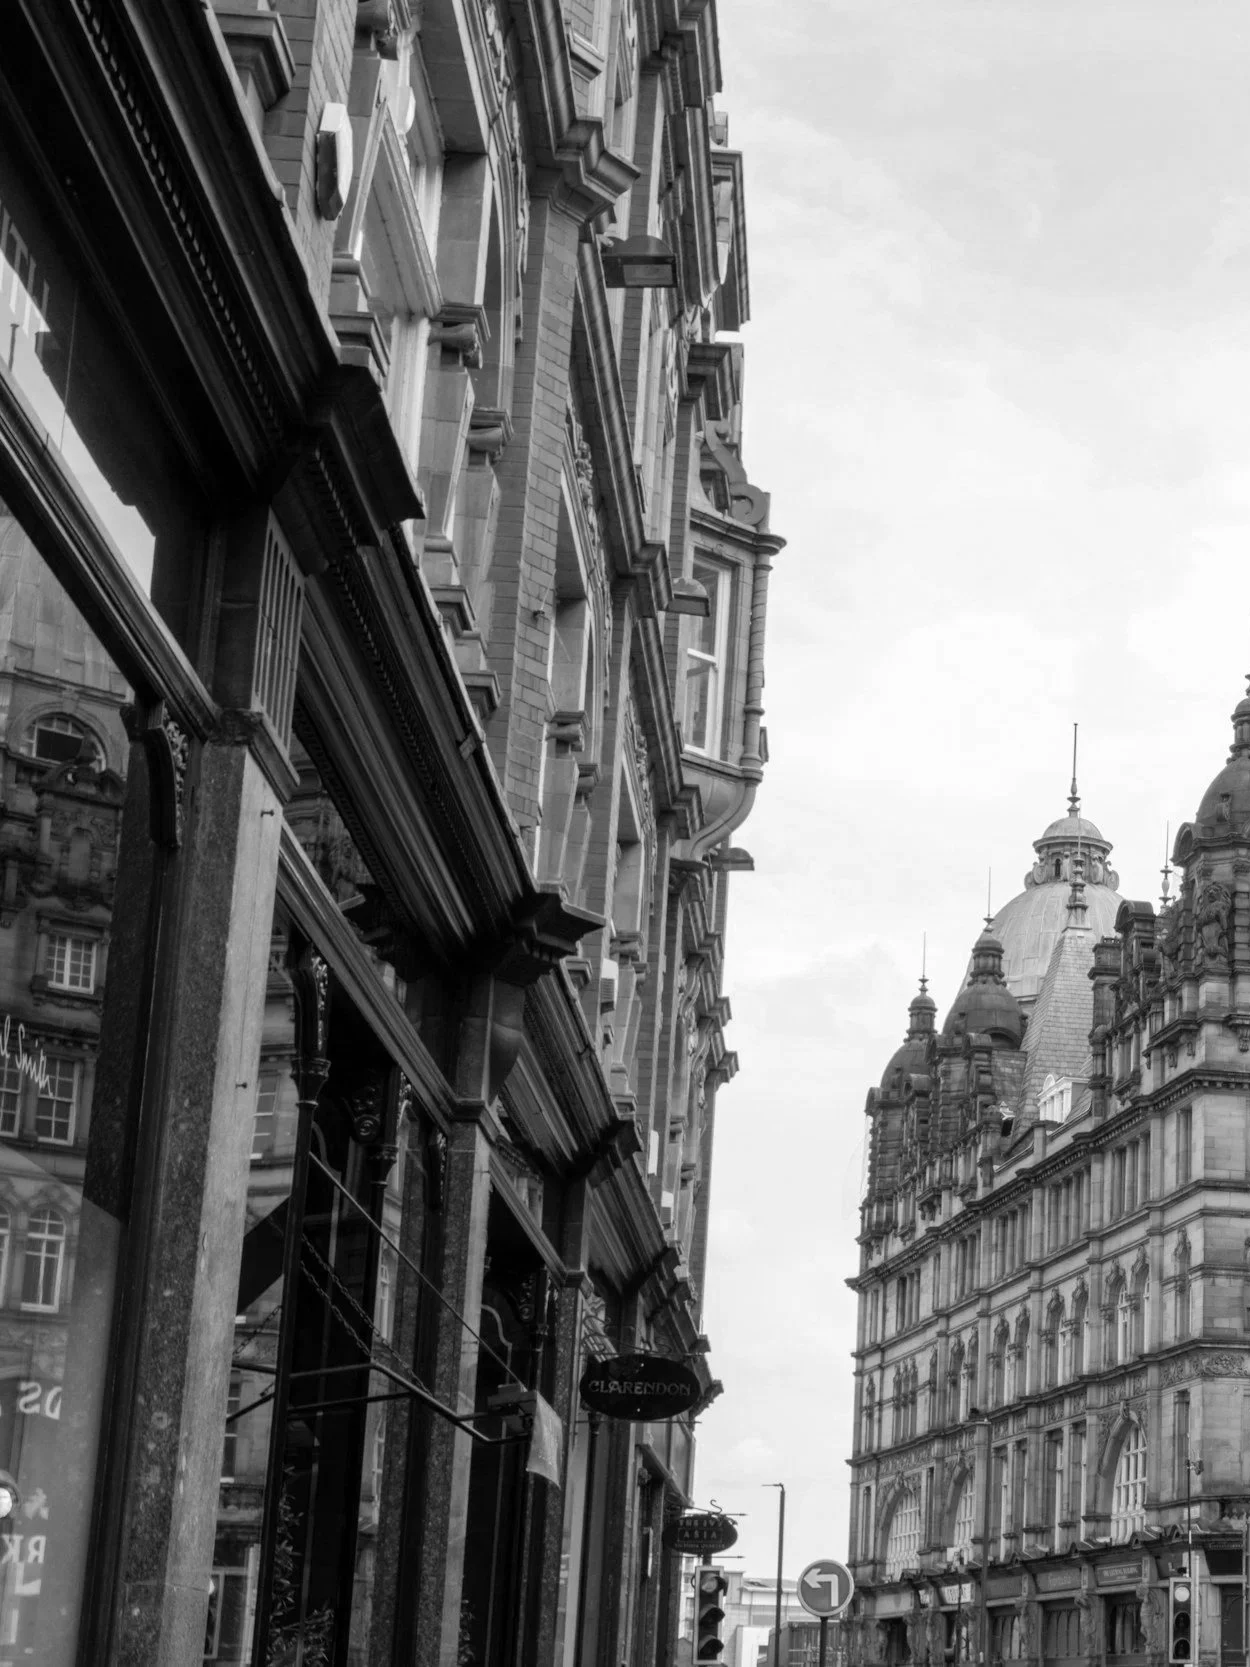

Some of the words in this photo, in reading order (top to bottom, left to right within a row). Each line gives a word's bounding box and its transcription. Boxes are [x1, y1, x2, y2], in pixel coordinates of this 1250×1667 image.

[15, 1023, 54, 1097] Smith
[588, 1380, 692, 1397] CLARENDON
[683, 1530, 717, 1540] ASIA
